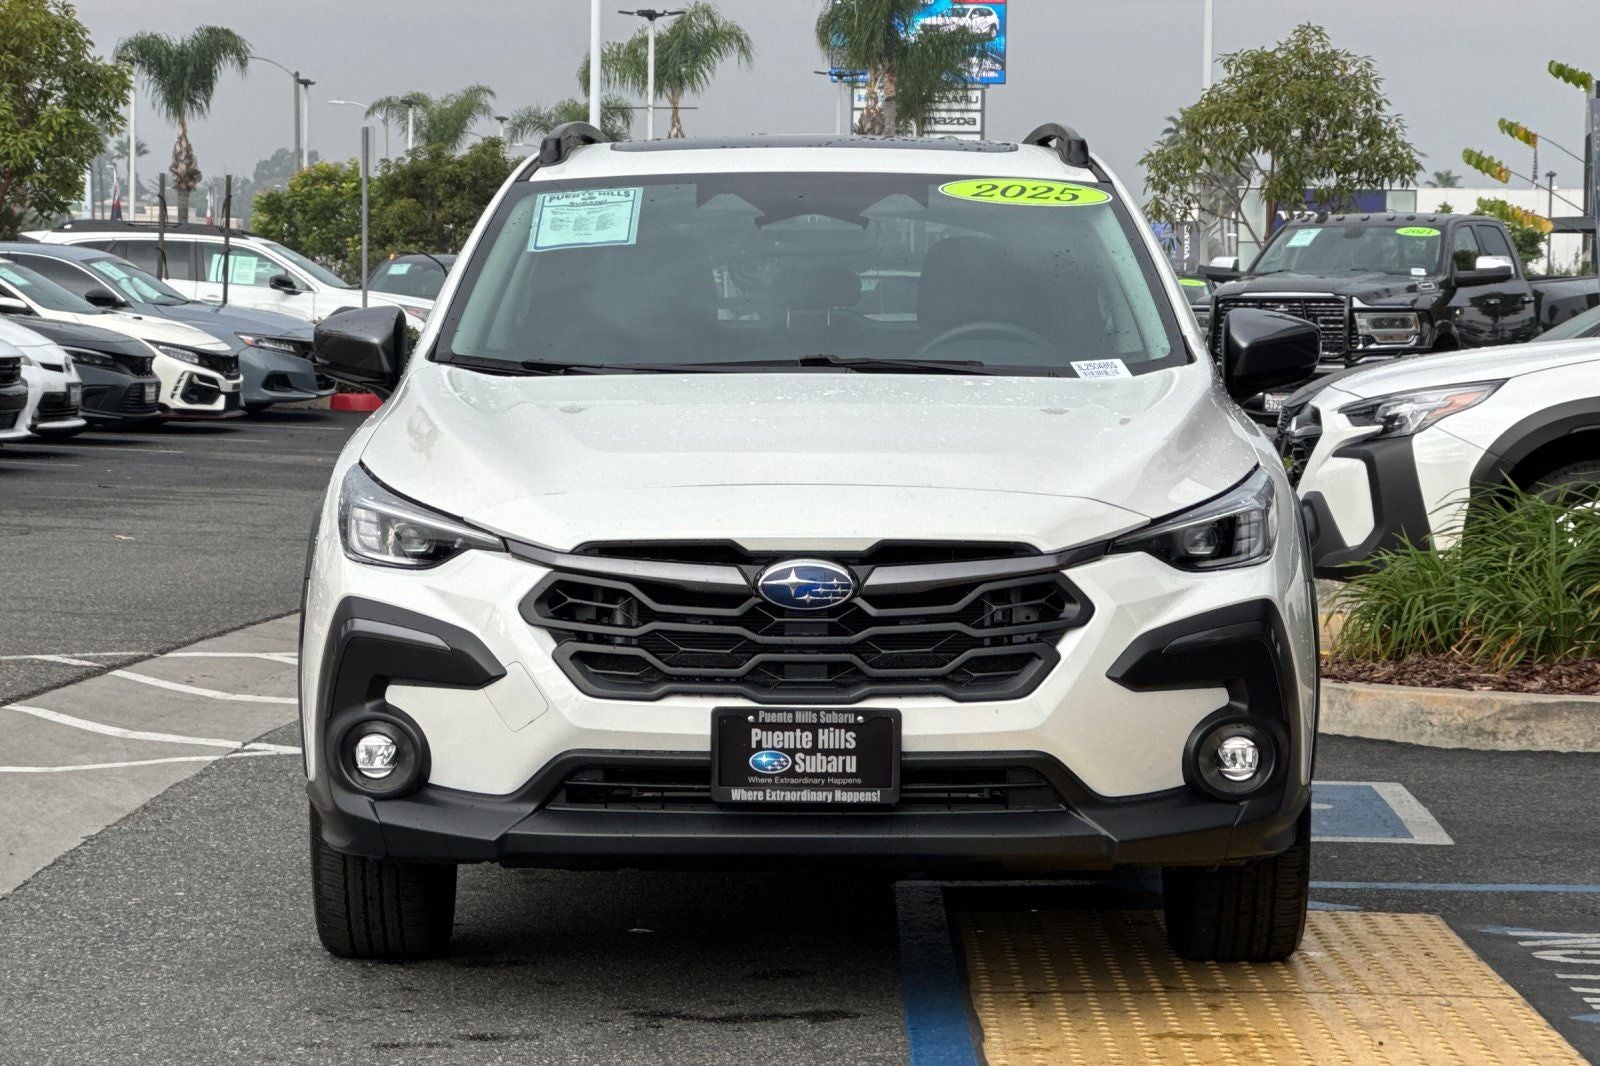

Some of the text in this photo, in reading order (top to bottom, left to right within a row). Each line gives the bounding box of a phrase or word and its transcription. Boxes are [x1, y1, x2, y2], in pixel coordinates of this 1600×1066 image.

[549, 190, 631, 203] PUENTE HILLS
[971, 183, 1082, 202] 2025
[758, 711, 855, 723] Puente Hills Subaru
[751, 728, 857, 749] Puente Hills
[794, 753, 857, 773] Subaru
[748, 776, 862, 786] Where Extraordinary Happens
[731, 789, 881, 803] Where Extraordinary Happens!
